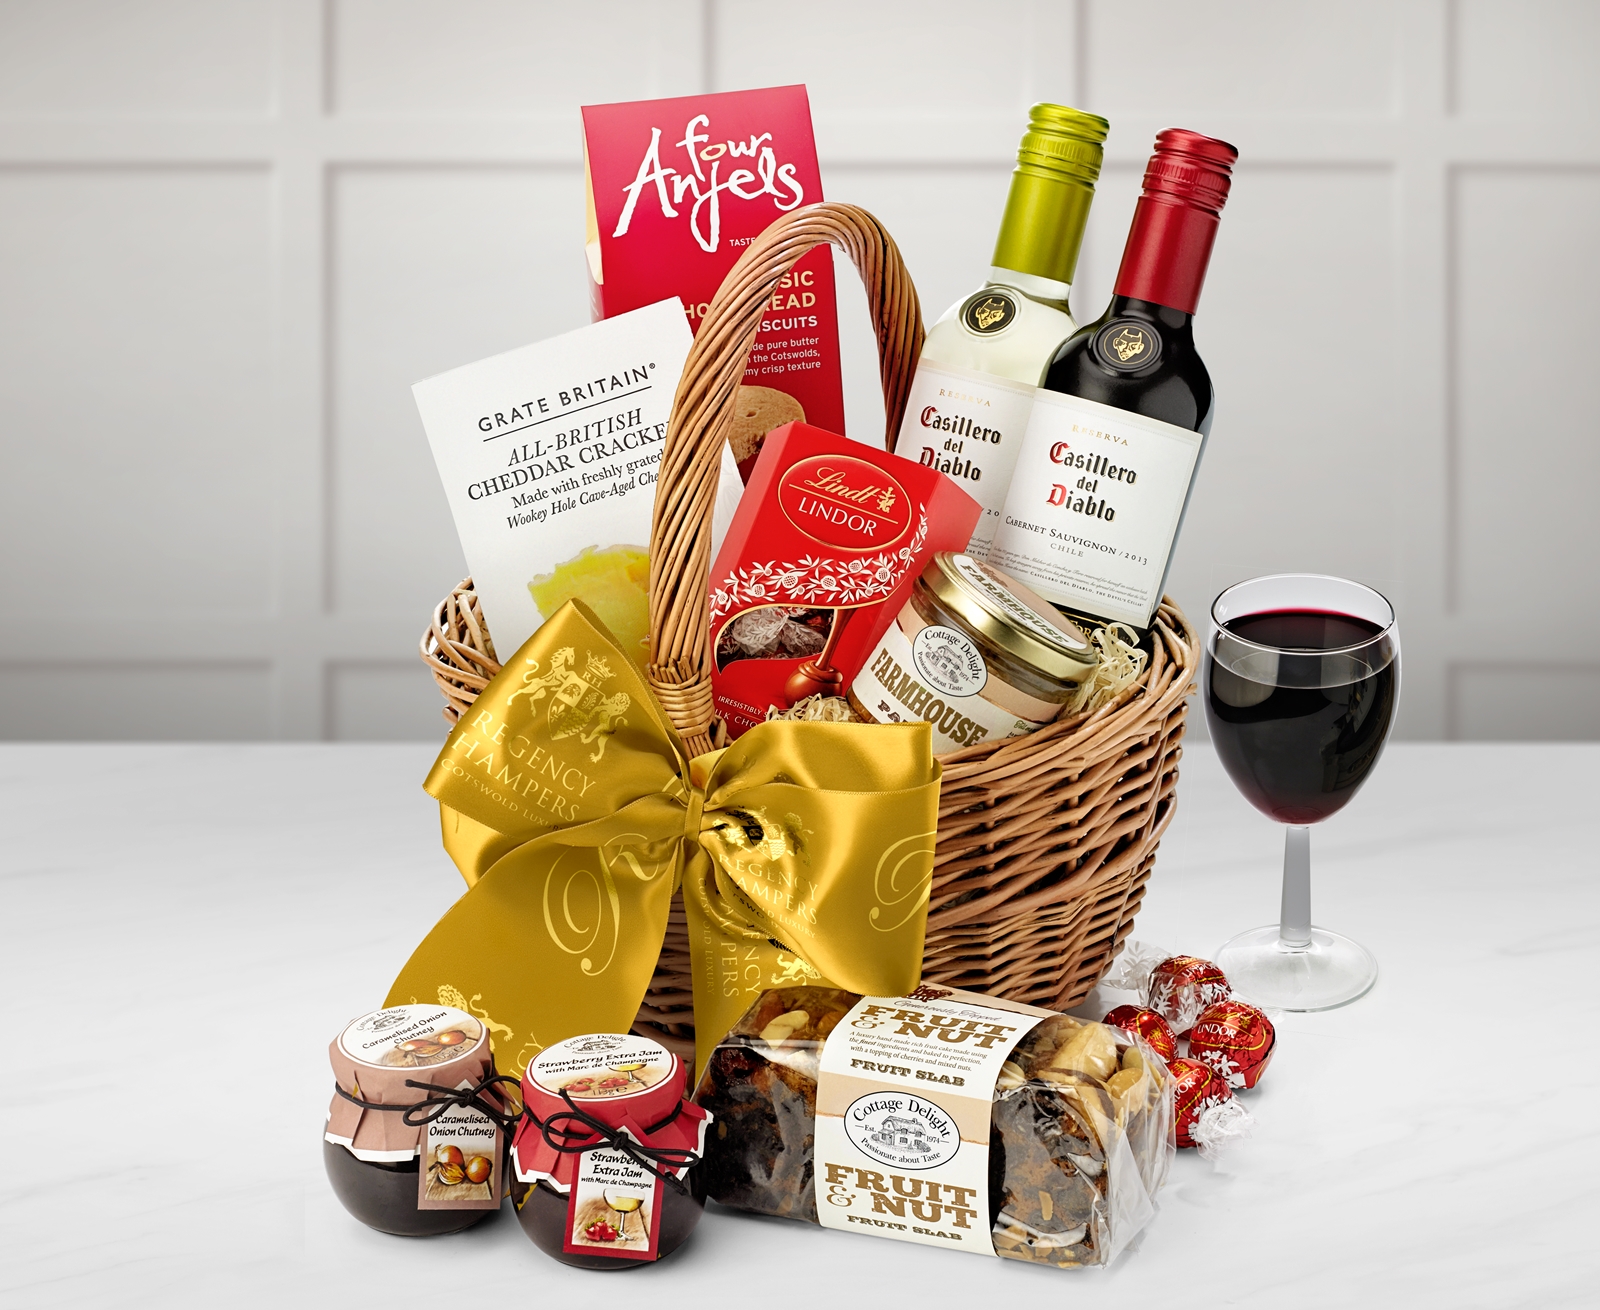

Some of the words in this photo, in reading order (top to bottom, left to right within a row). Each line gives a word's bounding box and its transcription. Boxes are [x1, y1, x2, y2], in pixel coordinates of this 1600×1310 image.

[676, 114, 772, 182] four
[753, 354, 768, 362] the
[770, 349, 820, 360] Cotswolds,
[767, 341, 788, 350] pure
[790, 337, 819, 346] butter
[762, 364, 785, 374] crisp
[787, 361, 821, 372] texture
[939, 388, 991, 407] RESERVA
[478, 398, 550, 432] GRATE
[921, 406, 1002, 444] Casillero
[508, 408, 642, 466] ALL-BRITISH
[944, 438, 964, 454] del
[1071, 424, 1128, 446] RESERVA
[467, 454, 575, 500] CHEDDAR
[579, 420, 670, 464] CRACKE
[919, 446, 982, 482] Diablo
[1050, 441, 1138, 484] Casillero
[511, 488, 550, 508] Made
[551, 478, 580, 496] with
[581, 464, 623, 487] freshly
[626, 448, 664, 474] grated
[804, 466, 881, 504] Lindt
[1076, 476, 1098, 494] del
[507, 506, 548, 529] Wookey
[550, 498, 577, 516] Hole
[579, 477, 636, 505] Cave-Aged
[638, 471, 659, 486] Che
[986, 508, 1000, 517] 20
[1046, 484, 1116, 522] Diablo
[798, 497, 877, 536] LINDOR
[1005, 516, 1046, 535] CABERNET
[1049, 528, 1116, 556] SAUVIGNON
[1124, 552, 1148, 566] 2013
[1050, 543, 1084, 558] CHILE
[961, 564, 1070, 644] FARMHOUSE
[925, 630, 960, 646] Cottage
[960, 643, 982, 680] Delight
[582, 671, 602, 688] RH
[932, 676, 946, 687] about
[948, 683, 963, 691] Taste
[718, 696, 762, 715] IRRESISTIBLY
[870, 648, 989, 747] FARMHOUSE
[878, 700, 908, 723] PA
[734, 716, 758, 728] CHO
[471, 709, 596, 798] REGENCY
[441, 758, 519, 812] COTSWOLD
[451, 732, 580, 822] HAMPERS
[719, 854, 818, 902] REGENCY
[729, 872, 817, 924] AMPERS
[780, 914, 816, 939] LUXURY
[705, 950, 714, 996] LUXURY
[362, 1024, 419, 1050] Caramelised
[418, 1011, 448, 1026] Onion
[851, 1016, 885, 1030] &
[894, 1022, 1008, 1050] NUT
[860, 1004, 1017, 1036] FRUIT
[1198, 1024, 1236, 1038] LINDOR
[394, 1026, 435, 1045] Chutney
[856, 1032, 876, 1040] luxury
[876, 1036, 910, 1045] hand-made
[971, 1052, 988, 1060] using
[538, 1056, 603, 1068] Strawberry
[606, 1051, 636, 1060] Extra
[605, 1057, 659, 1066] Champagne
[869, 1048, 892, 1058] topping
[900, 1054, 924, 1062] cherries
[876, 1042, 910, 1052] ingredients
[923, 1050, 942, 1058] baked
[949, 1056, 982, 1065] perfection,
[850, 1058, 911, 1076] FRUIT
[916, 1070, 965, 1086] SLAB
[430, 1126, 456, 1136] Onion
[458, 1126, 495, 1138] Chutney
[854, 1100, 902, 1122] Cottage
[908, 1099, 950, 1138] Delight
[864, 1124, 876, 1132] Est.
[926, 1135, 940, 1144] 1974
[861, 1138, 896, 1162] Passionate
[898, 1154, 920, 1164] about
[921, 1152, 941, 1163] Taste
[593, 1164, 620, 1176] Extra
[621, 1167, 643, 1178] Jam
[618, 1180, 652, 1190] Champagne
[825, 1163, 976, 1208] FRUIT
[826, 1186, 856, 1207] &
[870, 1192, 978, 1229] NUT
[846, 1214, 908, 1232] FRUIT
[912, 1227, 962, 1241] SLAB
